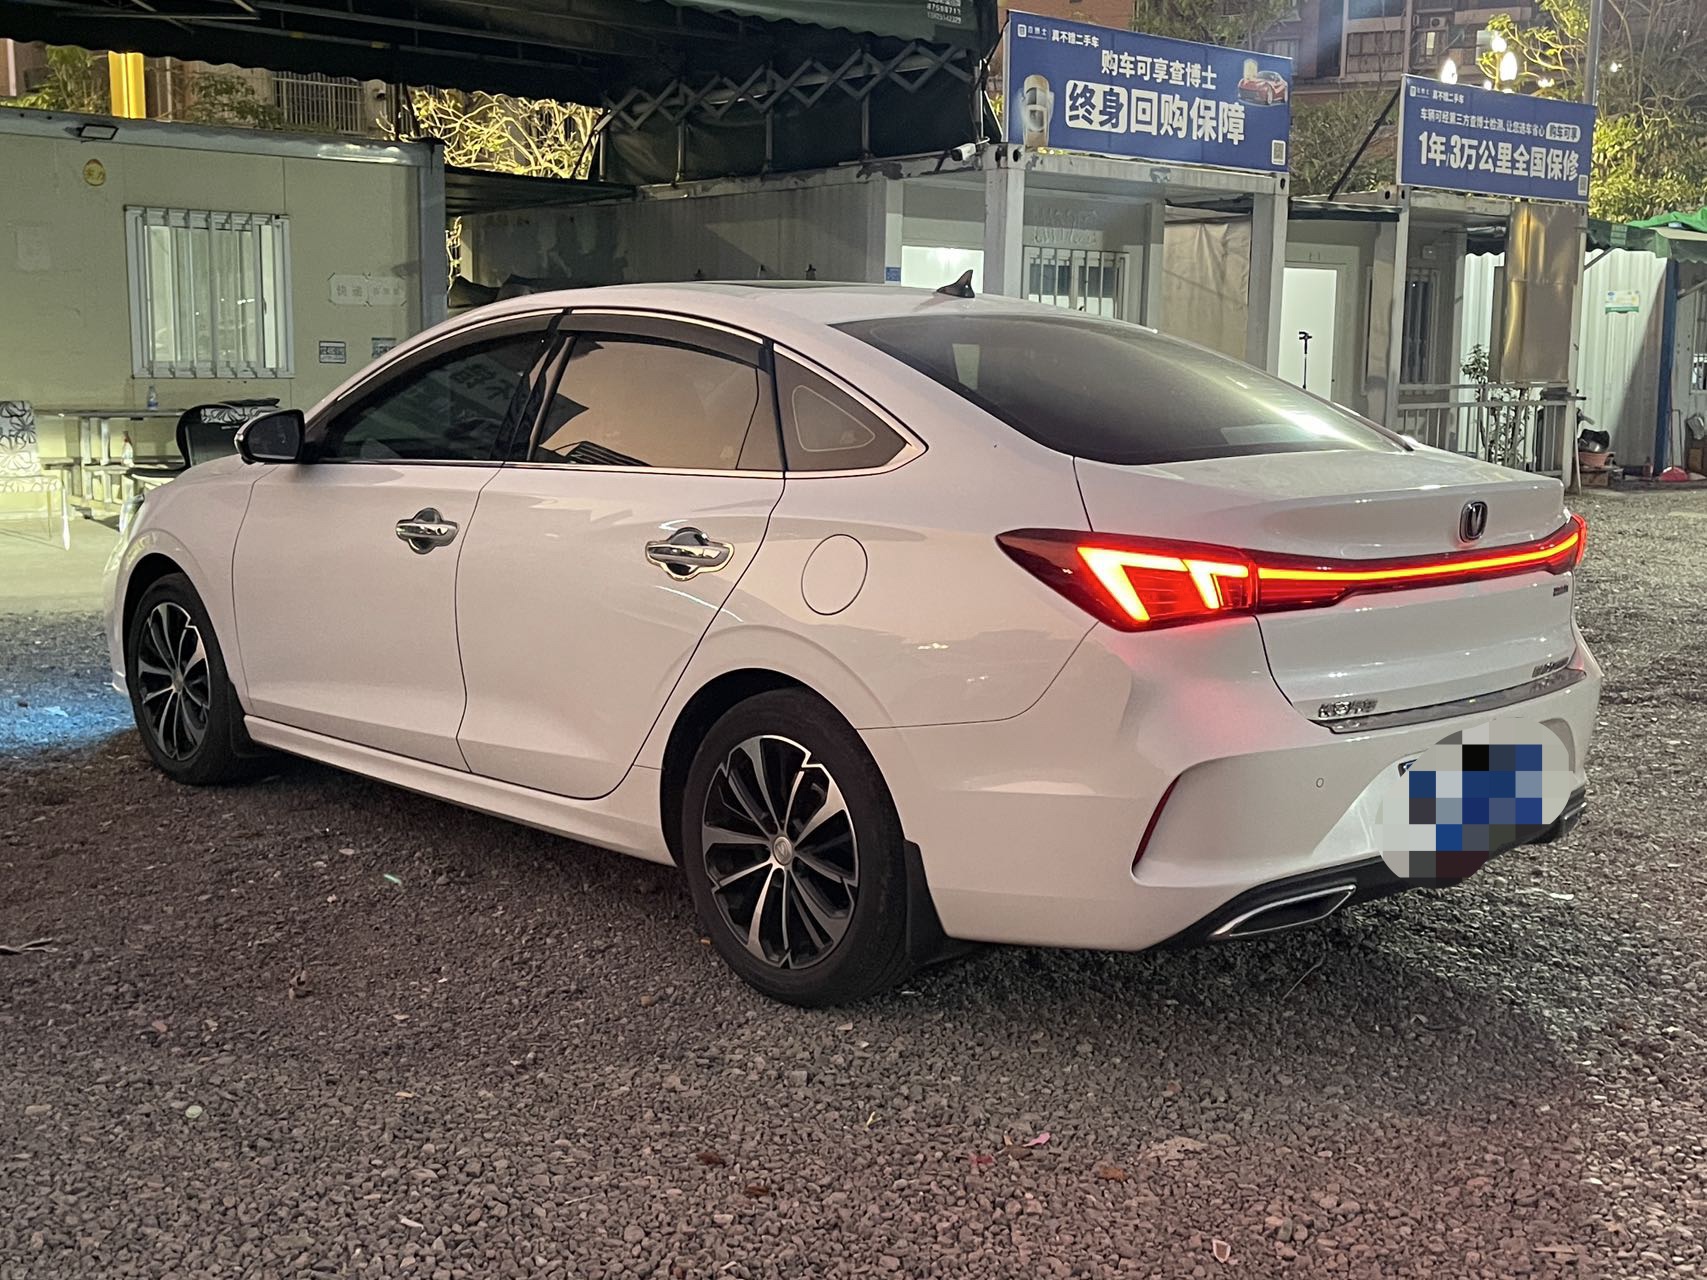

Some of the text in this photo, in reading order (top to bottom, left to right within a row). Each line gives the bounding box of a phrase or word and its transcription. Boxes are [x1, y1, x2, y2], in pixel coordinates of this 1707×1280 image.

[1052, 29, 1099, 48] 真不错二手车
[1101, 49, 1217, 90] 购车可享查博士
[1068, 82, 1245, 146] 终身回购保障
